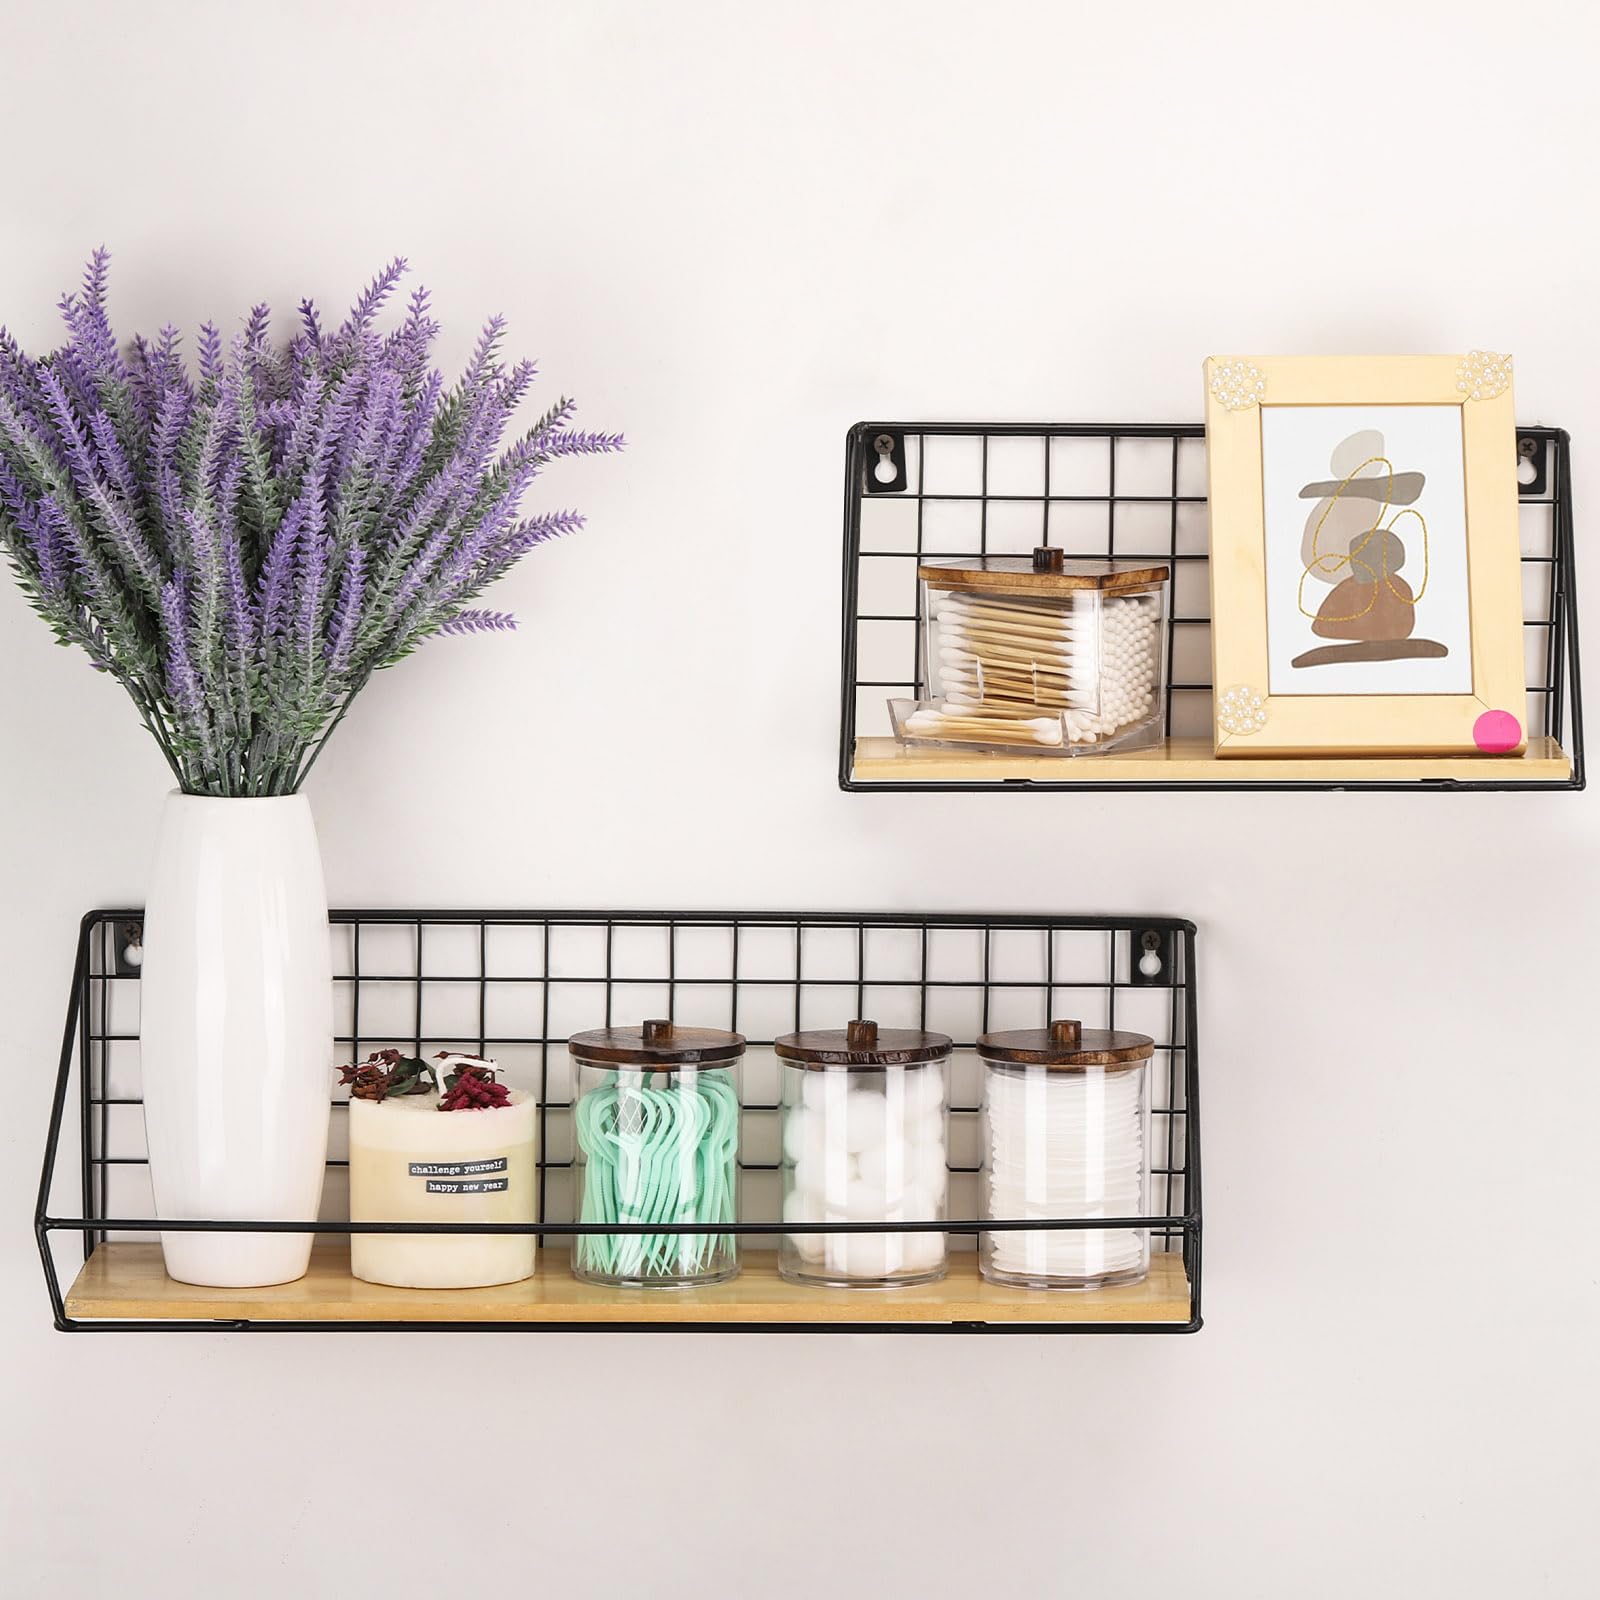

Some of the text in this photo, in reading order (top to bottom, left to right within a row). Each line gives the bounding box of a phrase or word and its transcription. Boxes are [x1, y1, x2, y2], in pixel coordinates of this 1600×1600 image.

[411, 1161, 503, 1175] challenge yourself
[429, 1182, 503, 1192] happy new year
